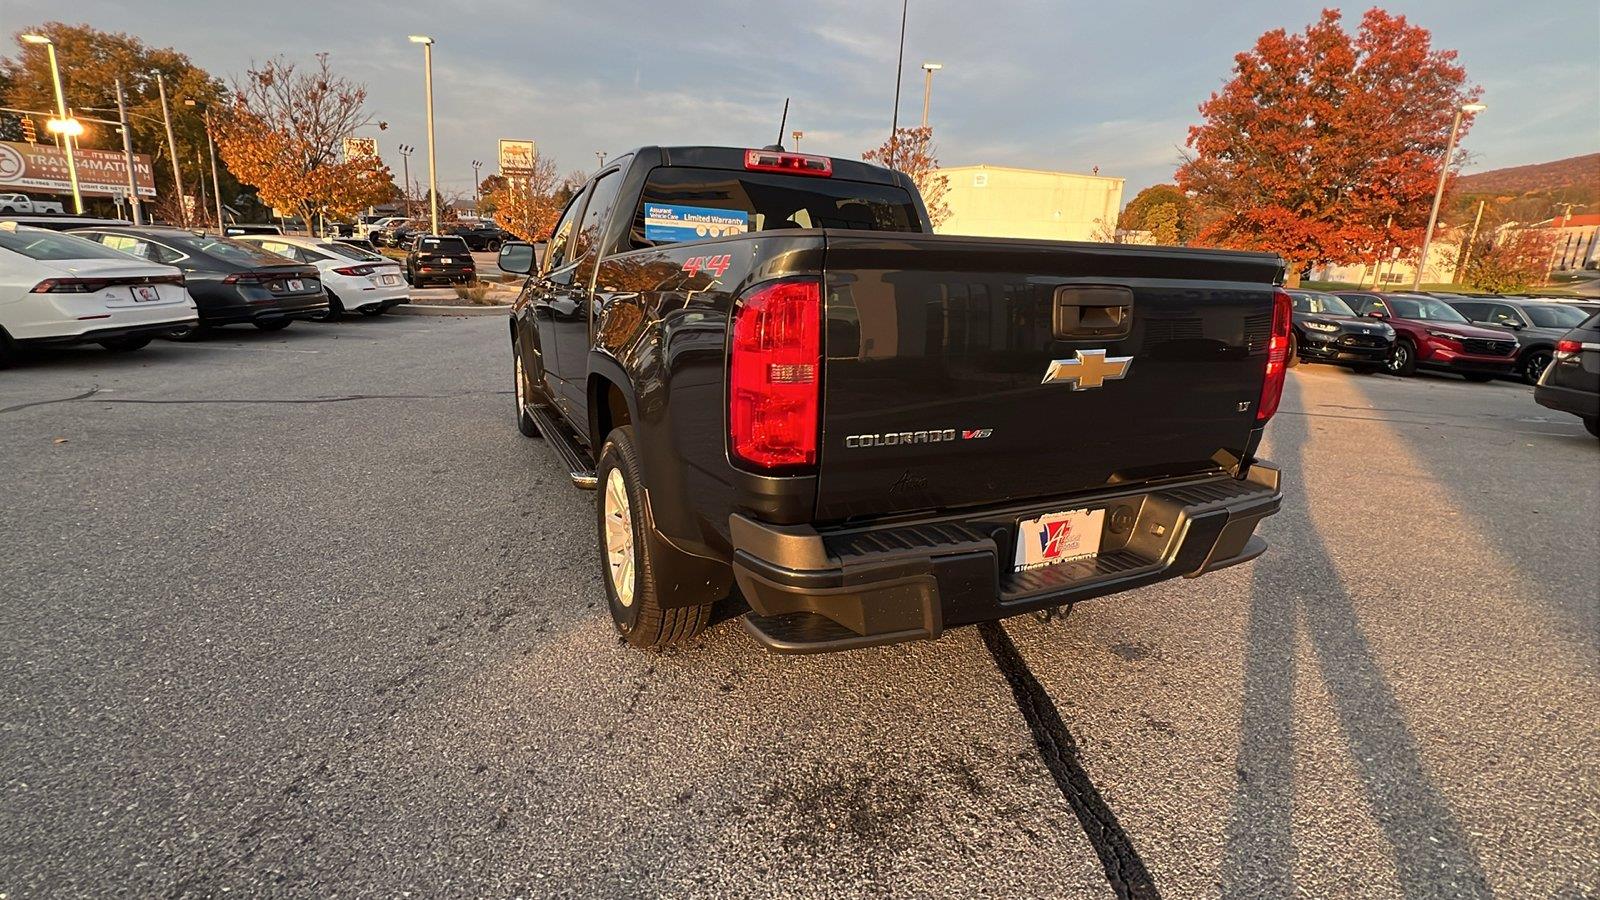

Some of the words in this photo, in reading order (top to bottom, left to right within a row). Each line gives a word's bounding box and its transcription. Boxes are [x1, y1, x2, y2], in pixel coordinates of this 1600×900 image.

[684, 213, 710, 223] Limited
[710, 215, 744, 226] Warranty
[1238, 401, 1251, 412] LT
[846, 429, 955, 448] COLORADO
[962, 429, 993, 439] V6
